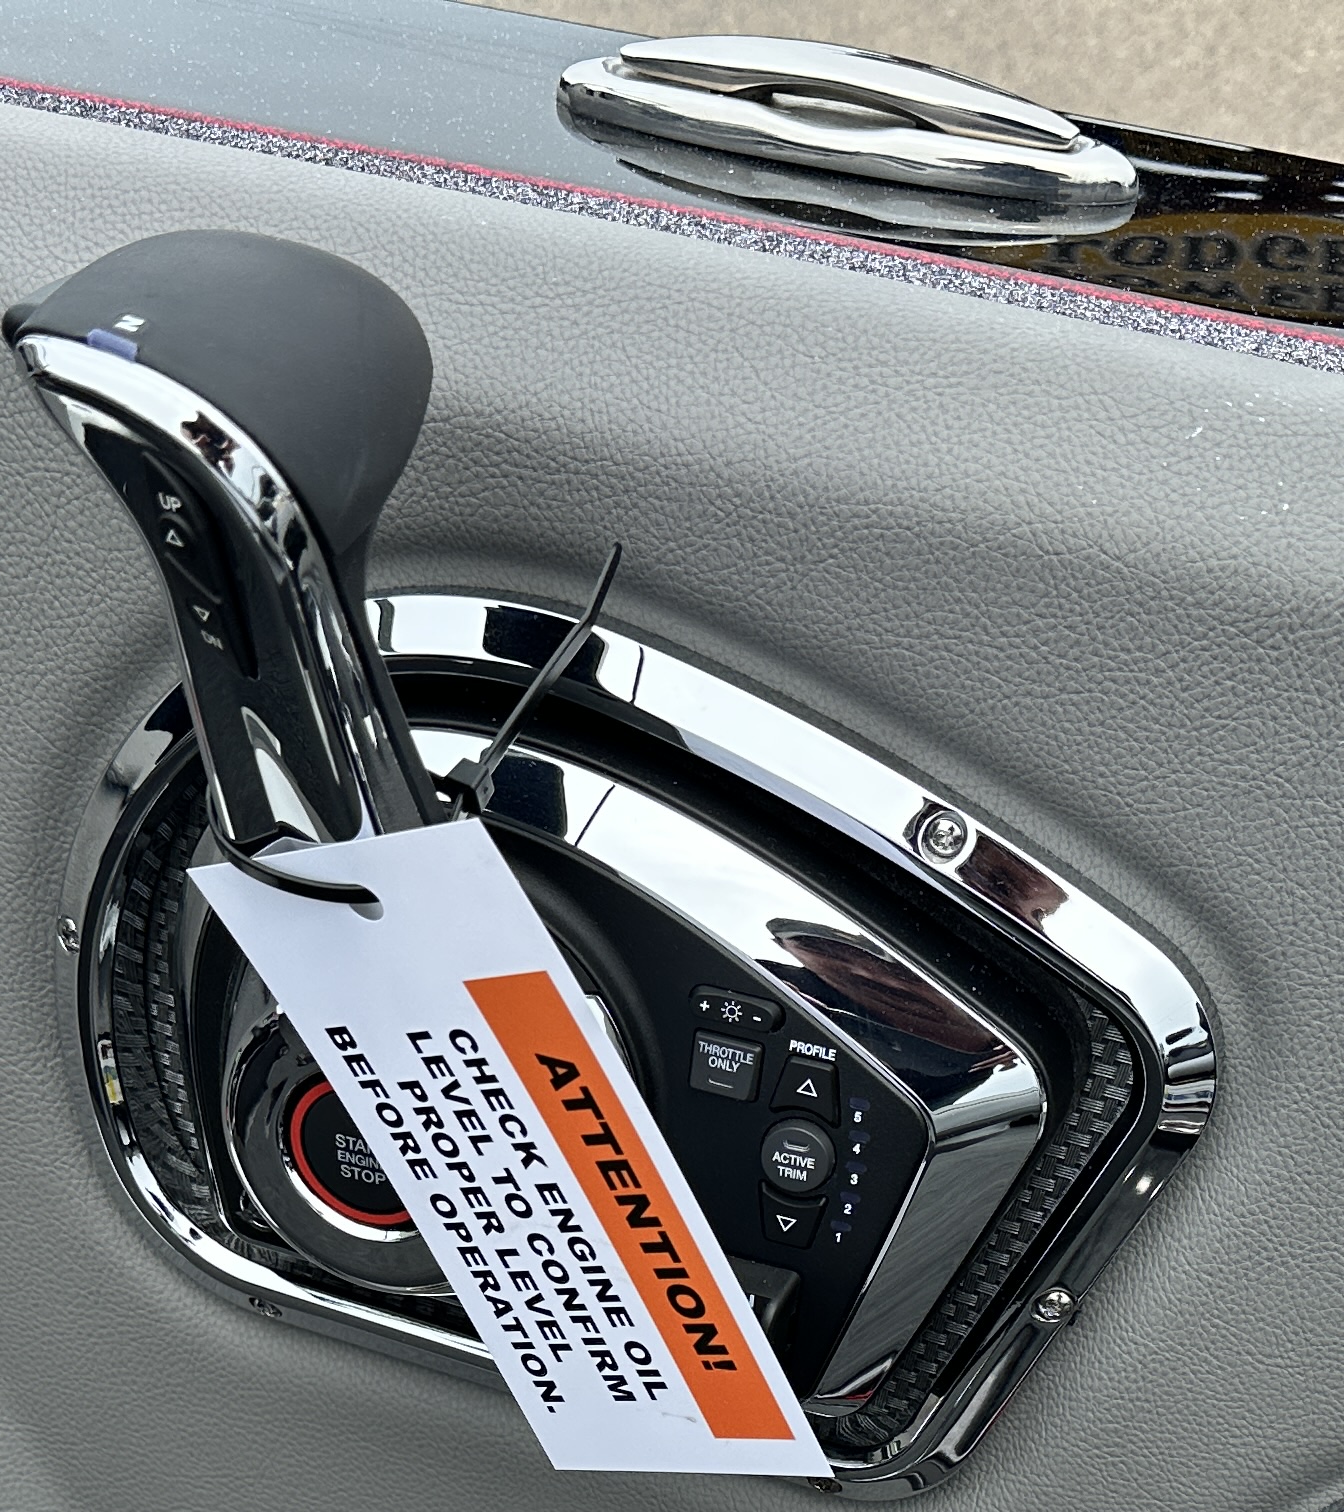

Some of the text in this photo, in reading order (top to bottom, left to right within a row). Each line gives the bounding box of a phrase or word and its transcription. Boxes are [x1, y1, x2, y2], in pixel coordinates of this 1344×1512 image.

[158, 492, 183, 513] UP
[698, 1040, 754, 1065] THROTTLE
[789, 1040, 837, 1062] PROFILE
[708, 1056, 740, 1073] ONLY
[853, 1111, 862, 1122] 5
[335, 1133, 372, 1154] STA
[852, 1143, 861, 1155] 4
[337, 1149, 383, 1170] ENGIN
[772, 1151, 815, 1170] ACTIVE
[340, 1164, 386, 1185] STOP
[777, 1165, 808, 1182] TRIM
[850, 1173, 859, 1185] 3
[325, 1026, 565, 1413] BEFORE OPERATION.
[406, 1030, 637, 1402] LEVEL TO CONFIRM
[448, 1029, 668, 1400] CHECK ENGINE OIL
[535, 1053, 737, 1371] ATTENTION!
[843, 1204, 852, 1215] 2
[397, 1080, 573, 1363] PROPER LEVEL
[835, 1232, 842, 1243] 1
